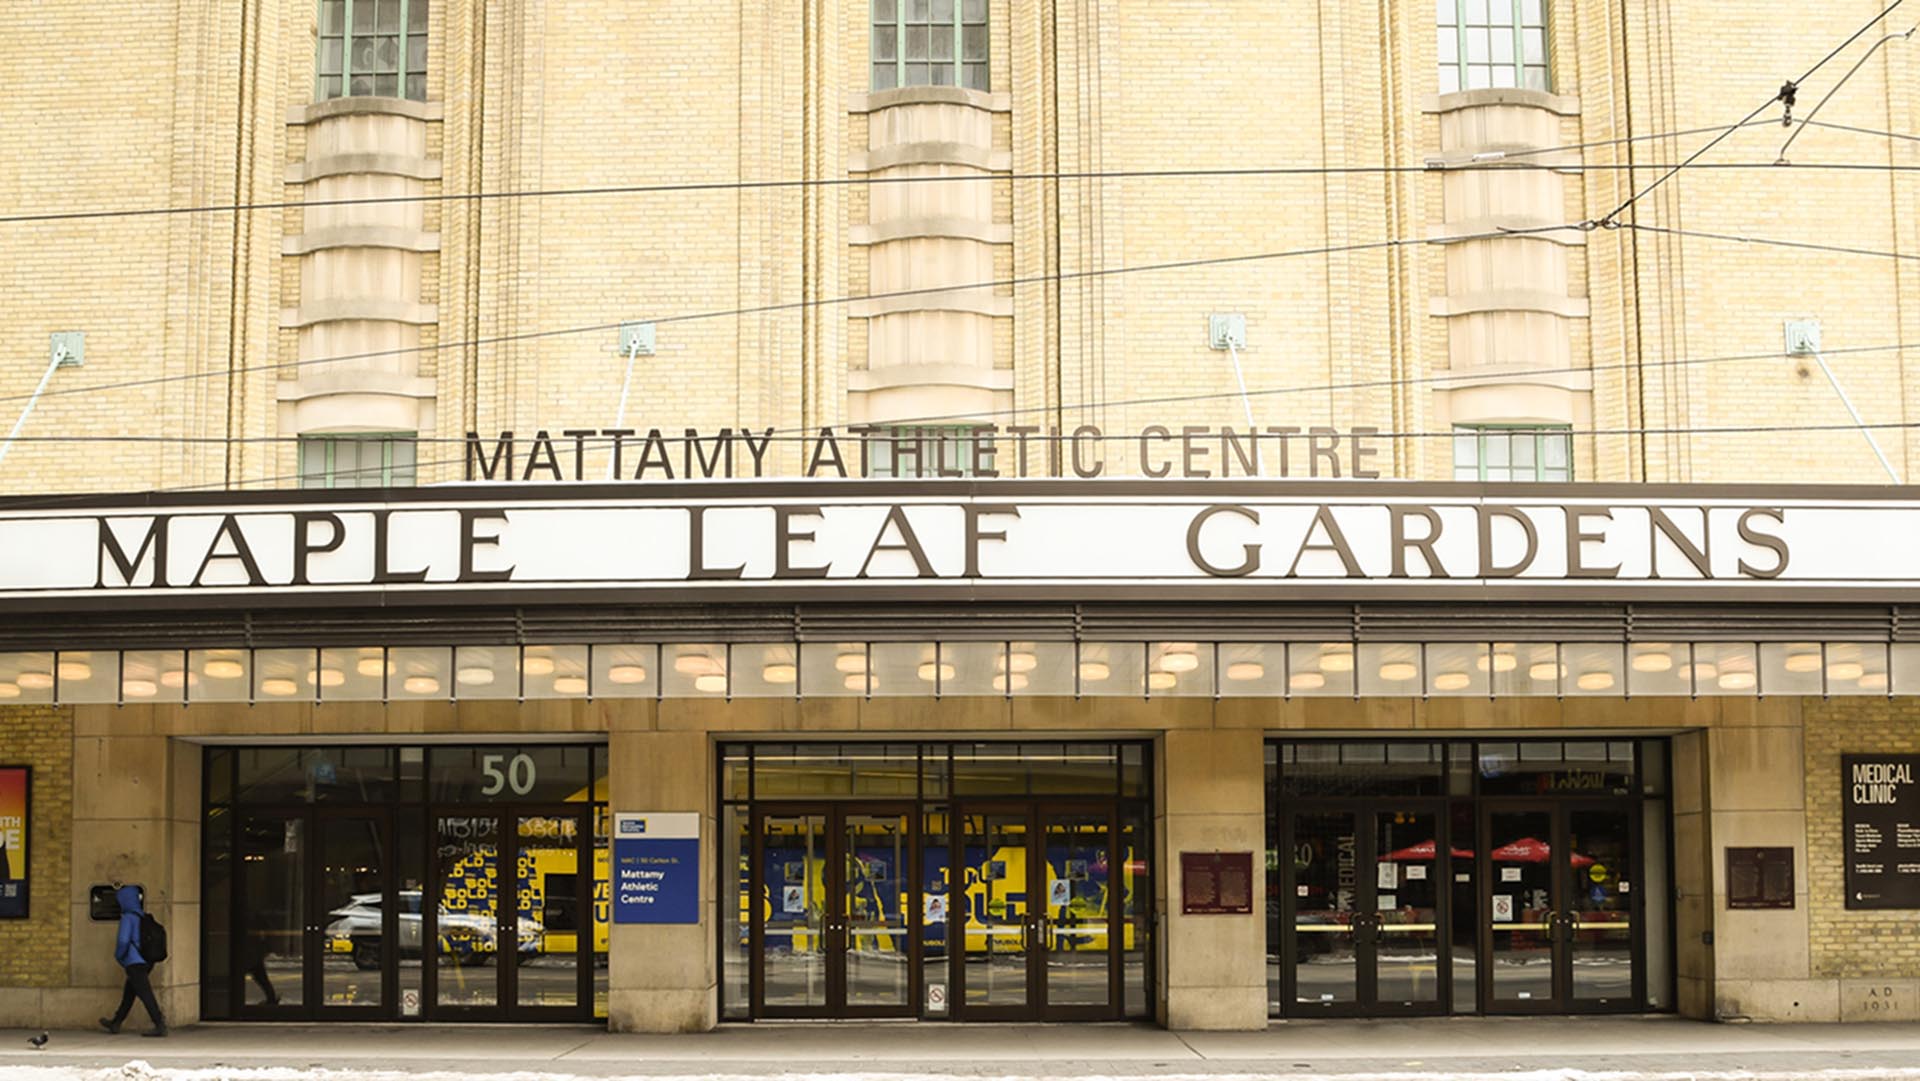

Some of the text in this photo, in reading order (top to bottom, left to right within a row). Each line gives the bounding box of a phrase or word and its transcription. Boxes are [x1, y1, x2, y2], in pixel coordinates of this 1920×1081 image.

[465, 426, 1381, 481] MATTAMY ATHLETIC CENTRE
[94, 503, 1790, 588] MAPLE LEAF GARDENS
[481, 753, 536, 796] 50
[1852, 764, 1914, 784] MEDICAL
[1853, 784, 1897, 804] CLINIC
[621, 869, 664, 881] Mattamy
[621, 881, 659, 892] Athletic
[621, 893, 655, 904] Centre
